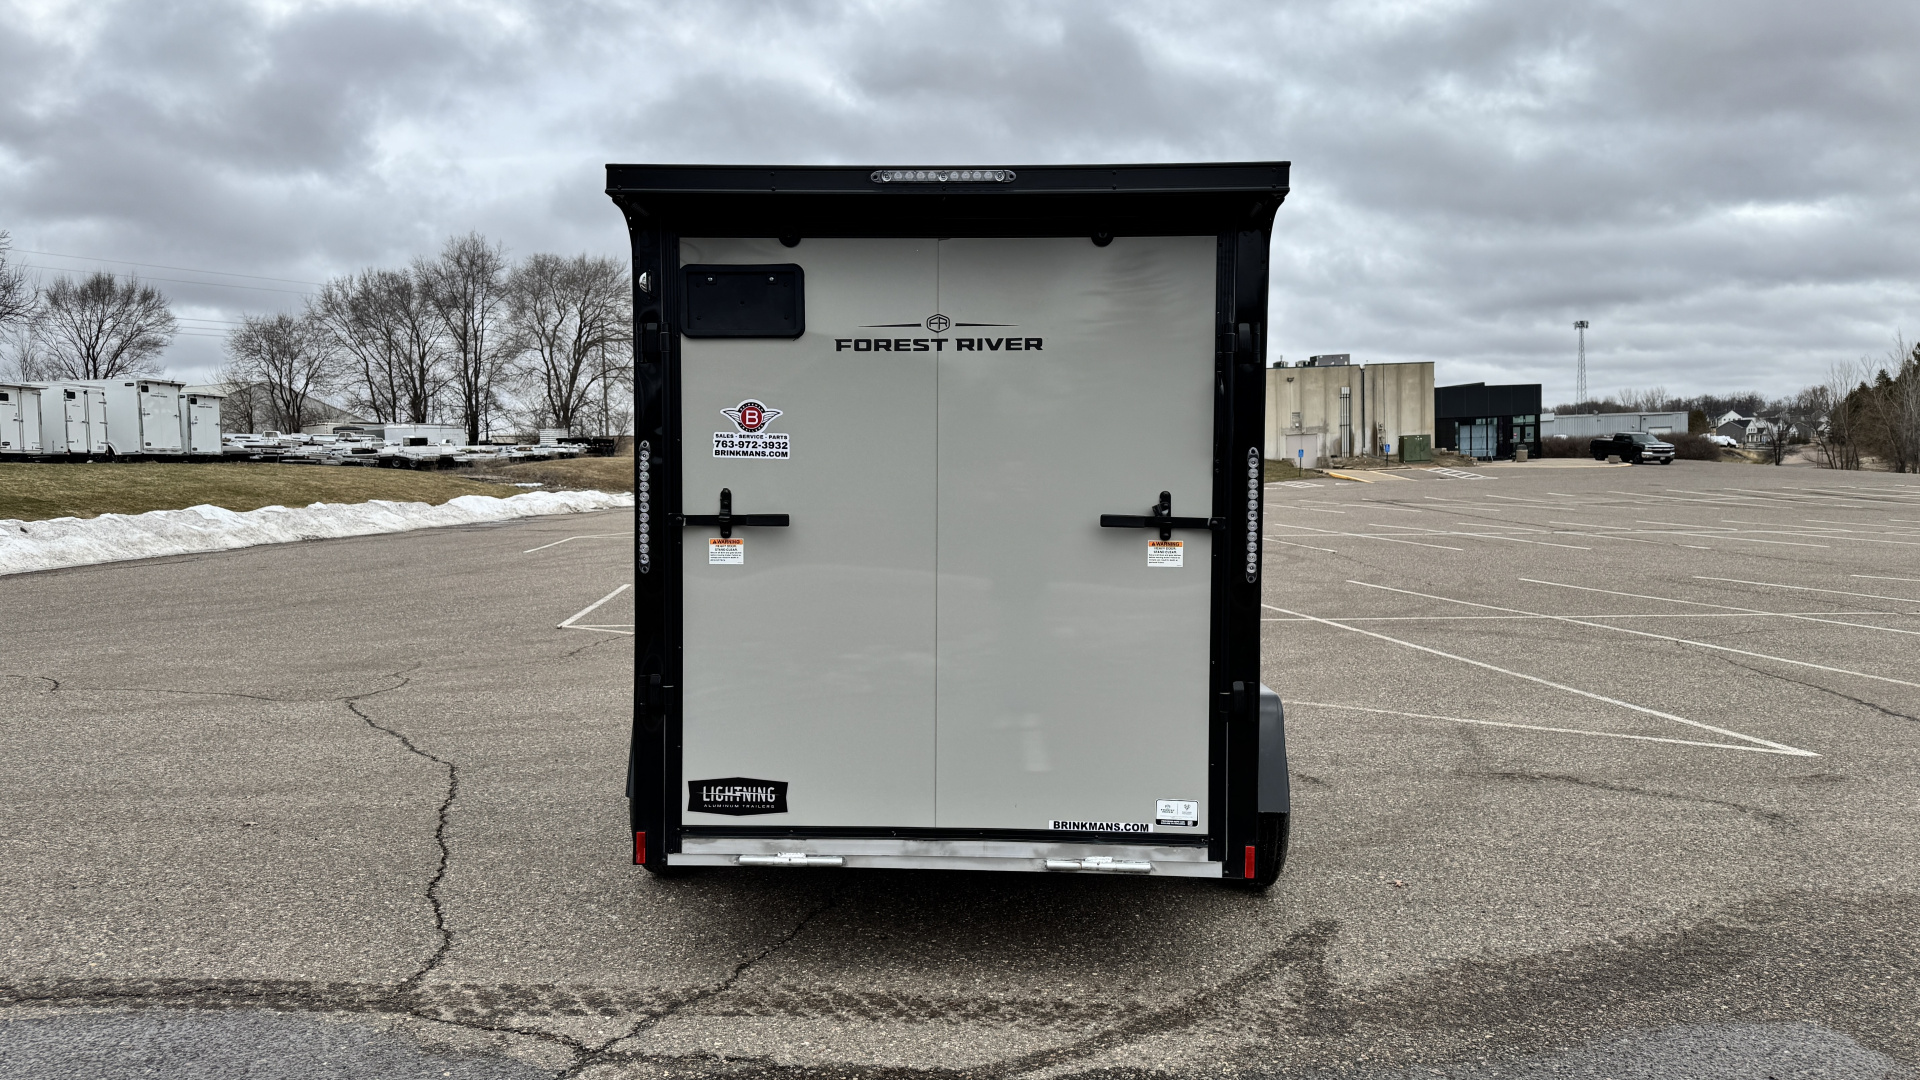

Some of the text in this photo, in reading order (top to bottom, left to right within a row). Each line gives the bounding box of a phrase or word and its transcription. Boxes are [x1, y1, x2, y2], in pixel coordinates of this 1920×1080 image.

[834, 337, 1043, 351] FOREST RIVER
[746, 410, 759, 424] B
[715, 440, 788, 449] 763-972-3932
[702, 786, 776, 802] LIGHTNING
[1053, 820, 1149, 832] BRINKMANS.COM
